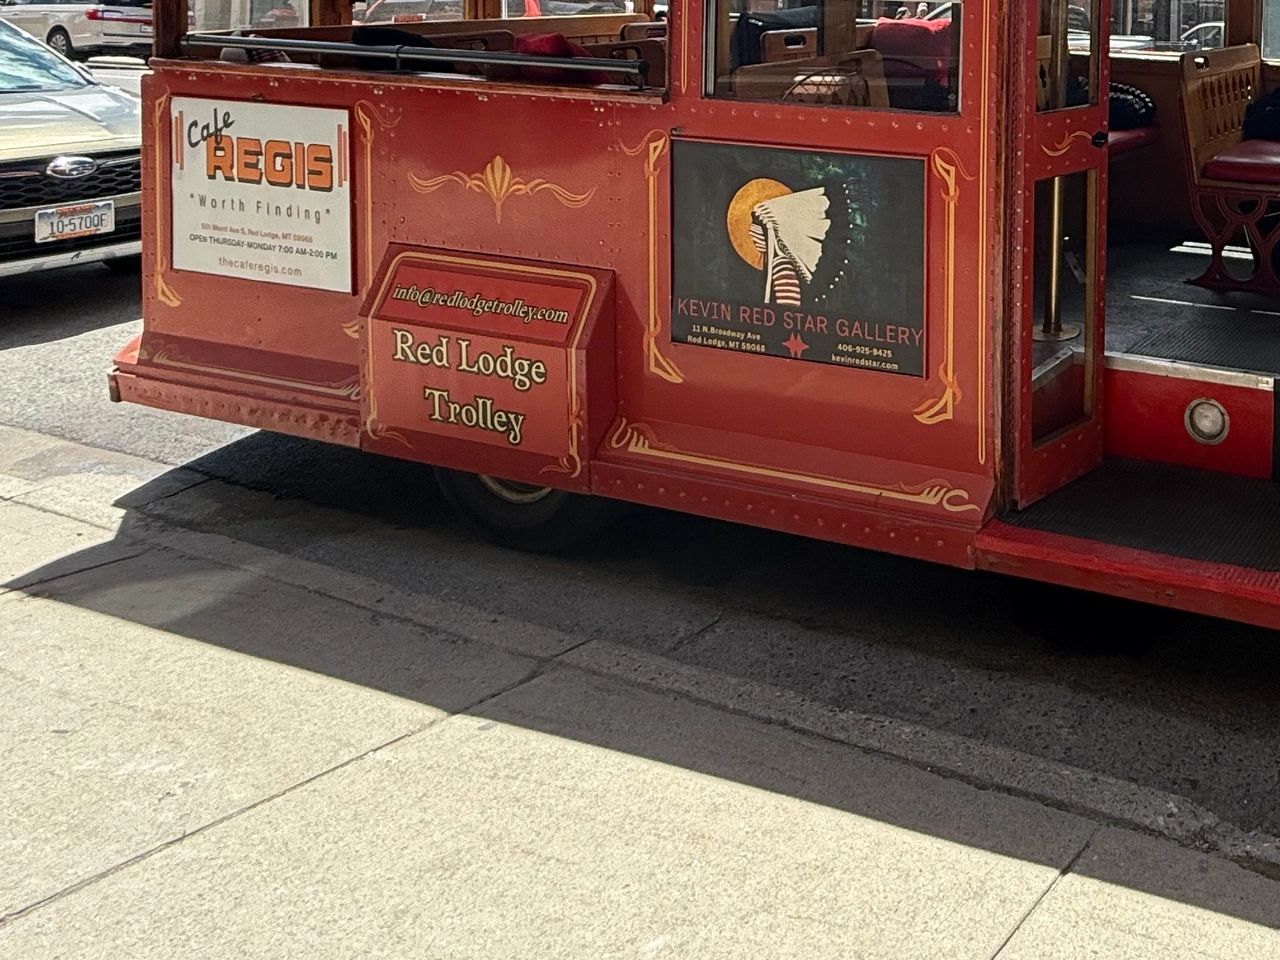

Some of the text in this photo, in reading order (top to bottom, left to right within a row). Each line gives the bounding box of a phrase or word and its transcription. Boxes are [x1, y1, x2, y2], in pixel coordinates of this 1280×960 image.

[187, 108, 235, 148] Cafe
[206, 134, 333, 192] REGIS
[190, 234, 208, 243] OPEN
[208, 236, 277, 252] THURSDAY-MONDAY
[325, 252, 338, 260] PM
[282, 232, 292, 240] MT
[218, 256, 302, 277] thecaferegis.com
[392, 284, 569, 324] info@redlodgetrolley.com
[678, 298, 923, 346] KEVIN RED STAR GALLERY
[746, 332, 761, 341] Ave
[688, 334, 702, 344] Red
[728, 339, 740, 350] MT
[392, 329, 547, 390] Red Lodge
[831, 353, 899, 371] kevinredstar.com
[424, 386, 524, 444] Trolley
